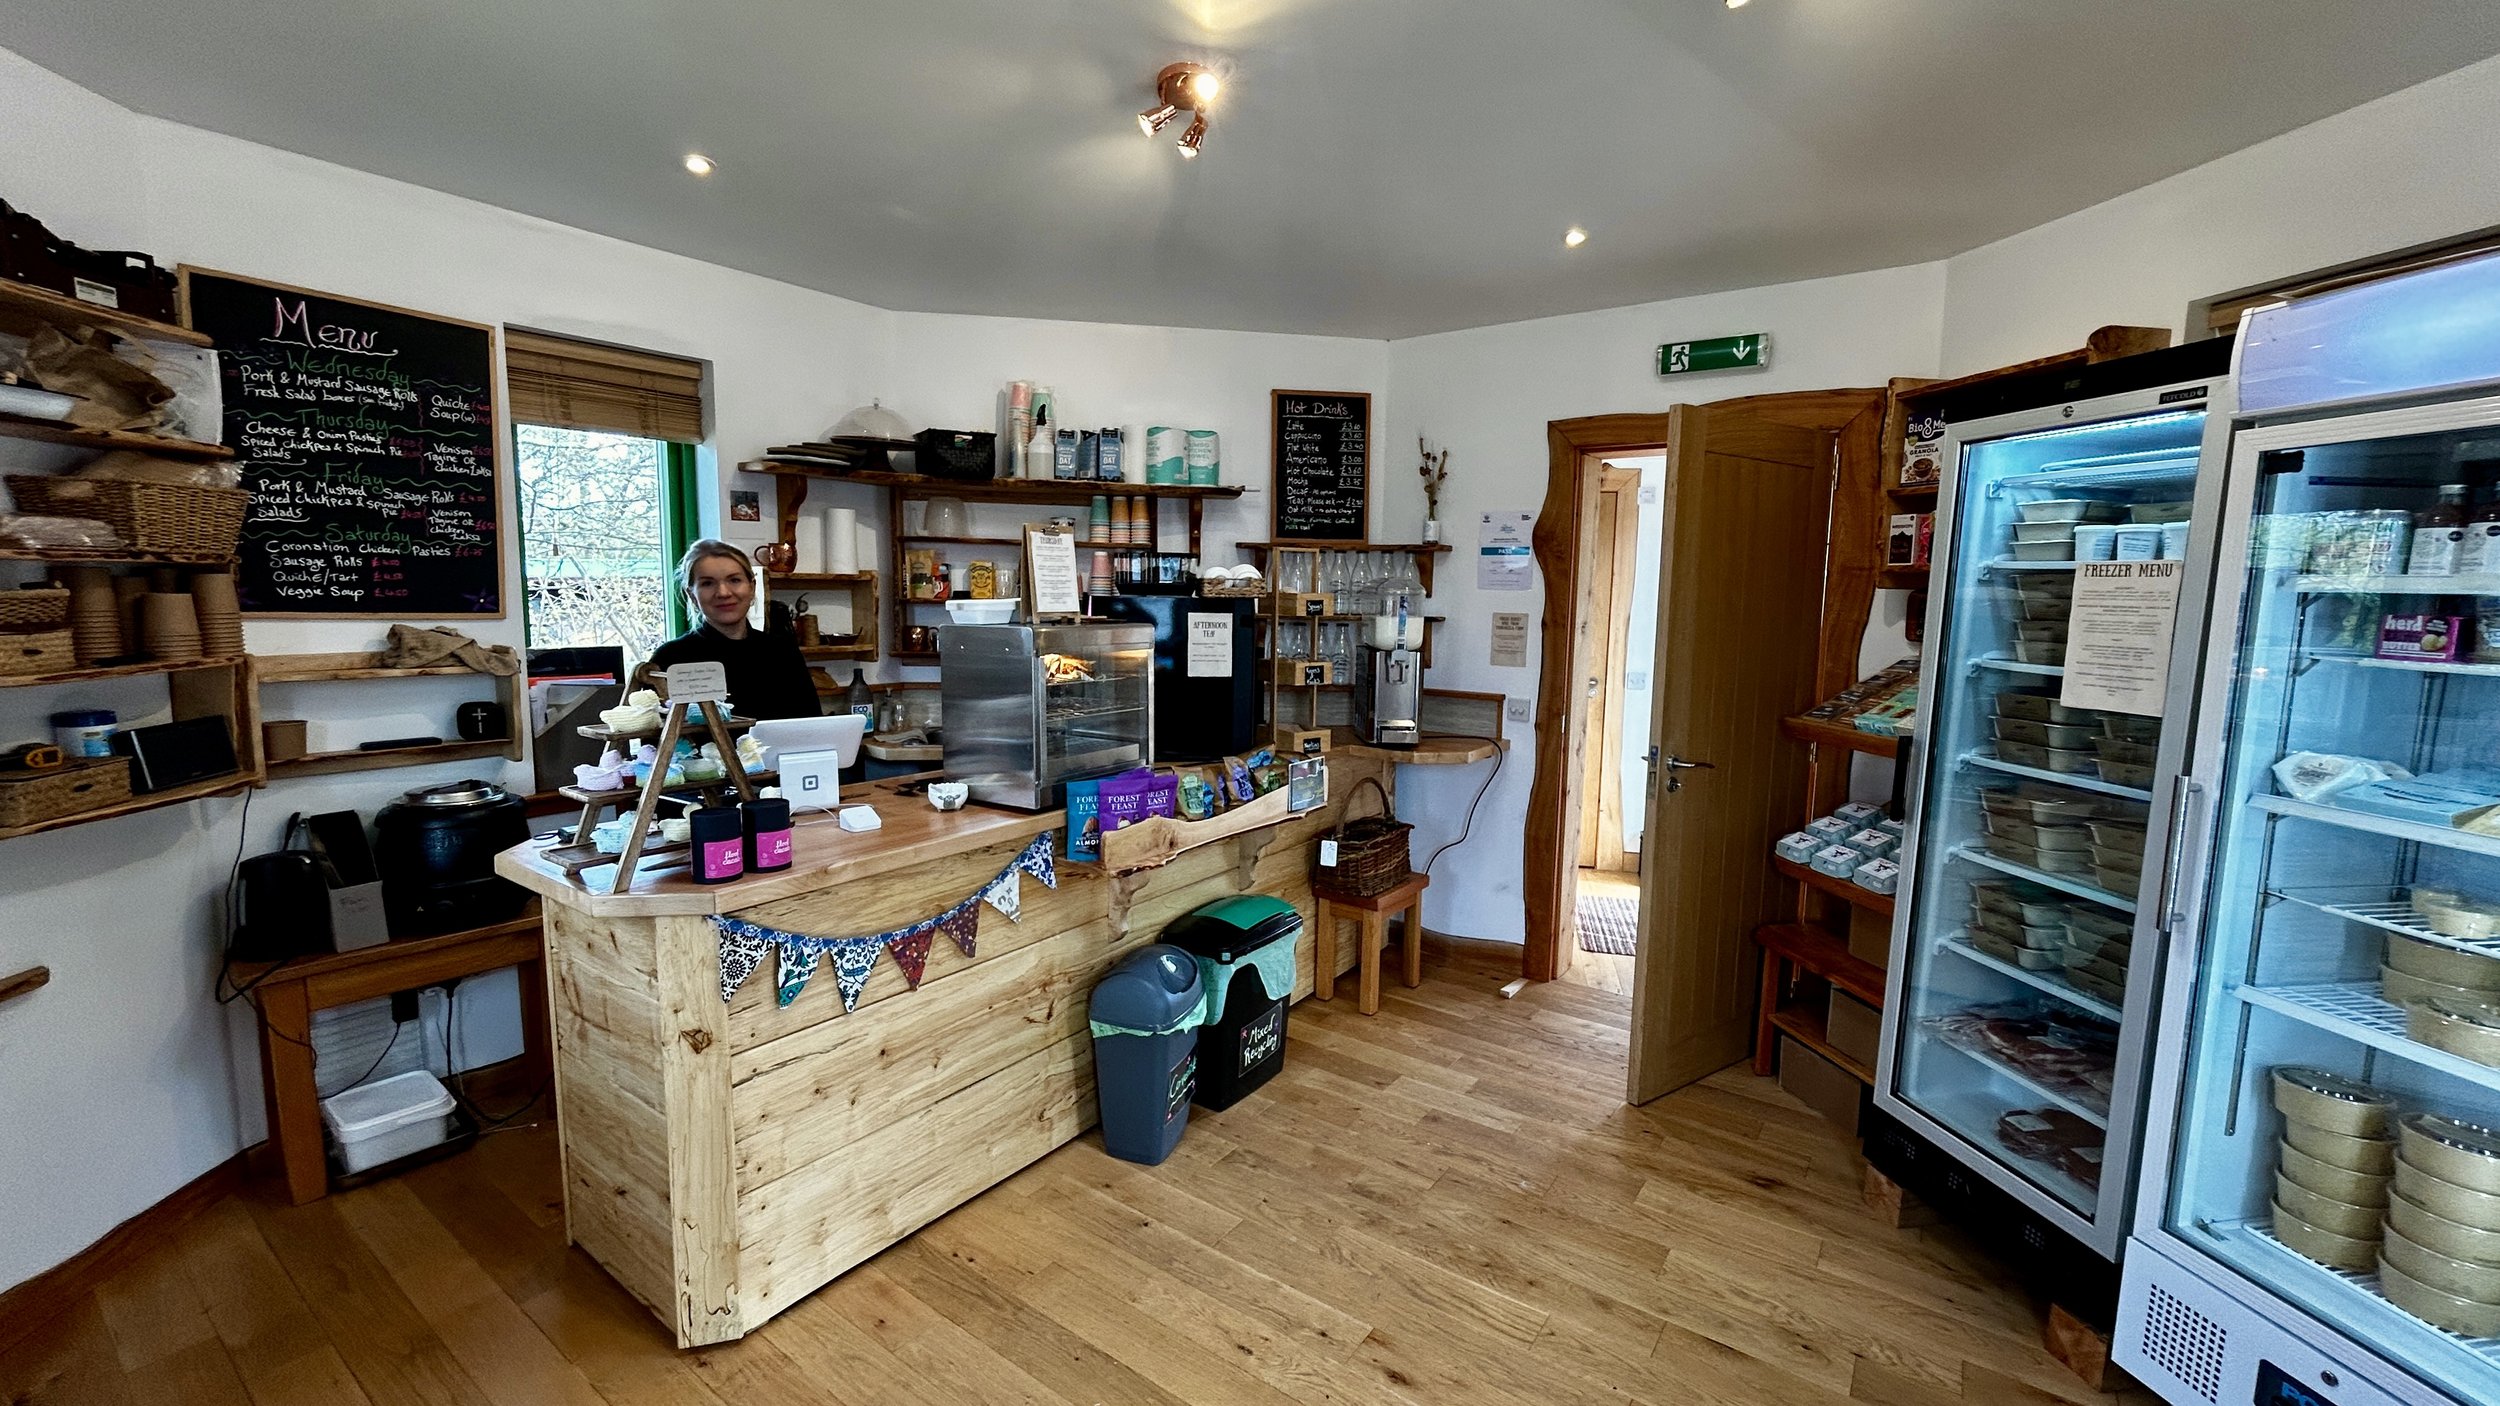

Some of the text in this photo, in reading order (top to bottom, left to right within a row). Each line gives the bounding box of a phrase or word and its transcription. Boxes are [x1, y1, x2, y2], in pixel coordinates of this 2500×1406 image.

[274, 297, 379, 350] Menu
[286, 350, 410, 391] Wednesday
[240, 365, 418, 402] Pork & Mustard Sausage Rolls
[243, 383, 281, 398] Fresh
[285, 388, 316, 401] Salad
[431, 394, 470, 410] Quiche
[1286, 400, 1349, 416] Hot Drinks
[295, 405, 389, 440] Thursday
[429, 407, 460, 422] Soup
[245, 420, 297, 436] Cheese
[302, 427, 311, 438] &
[1286, 420, 1305, 431] Latte
[240, 435, 276, 447] Spiced
[333, 443, 342, 452] &
[389, 446, 403, 456] Pie
[252, 447, 291, 459] Salads
[433, 443, 473, 455] Venison
[1910, 447, 1939, 455] GRANOLA
[1285, 452, 1328, 464] Americano
[323, 462, 385, 494] Friday
[1286, 466, 1300, 475] Hot
[1302, 466, 1335, 476] Chocolate
[248, 491, 290, 505] Spiced
[356, 497, 364, 508] &
[258, 479, 290, 492] Pork
[295, 481, 304, 493] &
[315, 481, 367, 497] Mustard
[384, 488, 429, 506] Sausage
[431, 490, 455, 503] Rolls
[258, 505, 303, 519] Salads
[431, 508, 472, 518] Venison
[325, 522, 411, 554] Saturday
[265, 540, 350, 553] Coronation
[359, 543, 401, 555] Chicken
[412, 545, 452, 557] Pasties
[269, 554, 327, 572] Sausage
[333, 555, 363, 567] Rolls
[2084, 563, 2174, 578] FREEZER MENU
[276, 585, 325, 599] Veggie
[330, 585, 365, 602] Soup
[2385, 615, 2424, 632] herd
[1076, 796, 1099, 804] FORE
[1108, 793, 1141, 804] FOREST
[1147, 789, 1170, 798] REST
[1147, 796, 1168, 805] EAST
[1079, 803, 1099, 811] FEA
[1111, 801, 1139, 811] FEAST
[1248, 1013, 1276, 1045] Mixed
[1244, 1034, 1278, 1067] Recycling
